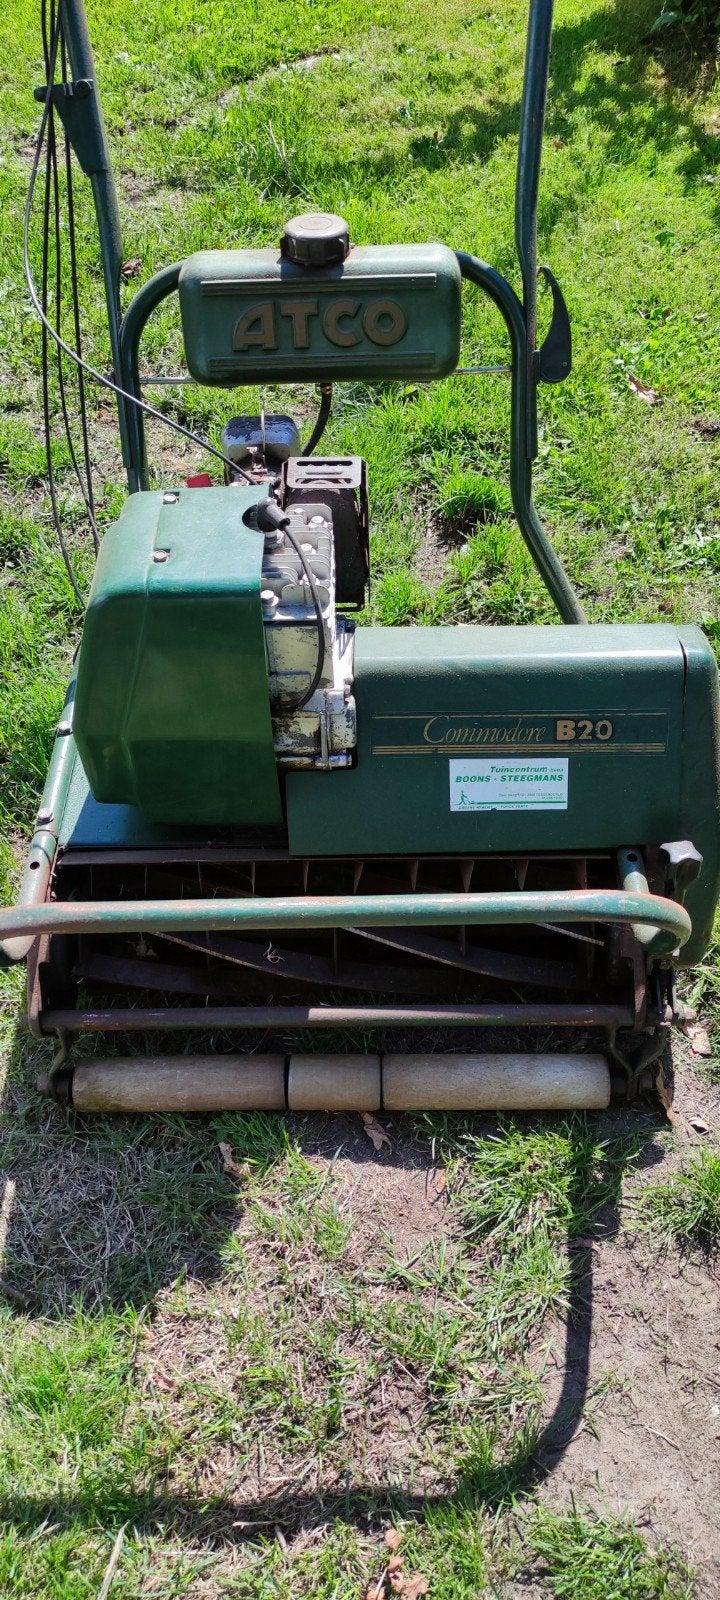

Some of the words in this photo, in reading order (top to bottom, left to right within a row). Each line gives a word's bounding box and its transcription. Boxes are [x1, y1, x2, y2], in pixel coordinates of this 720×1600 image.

[233, 299, 408, 352] ATCO
[423, 715, 546, 744] Commodore
[555, 719, 614, 741] B20
[455, 775, 491, 783] BOONS
[500, 774, 564, 782] STEEGMANS
